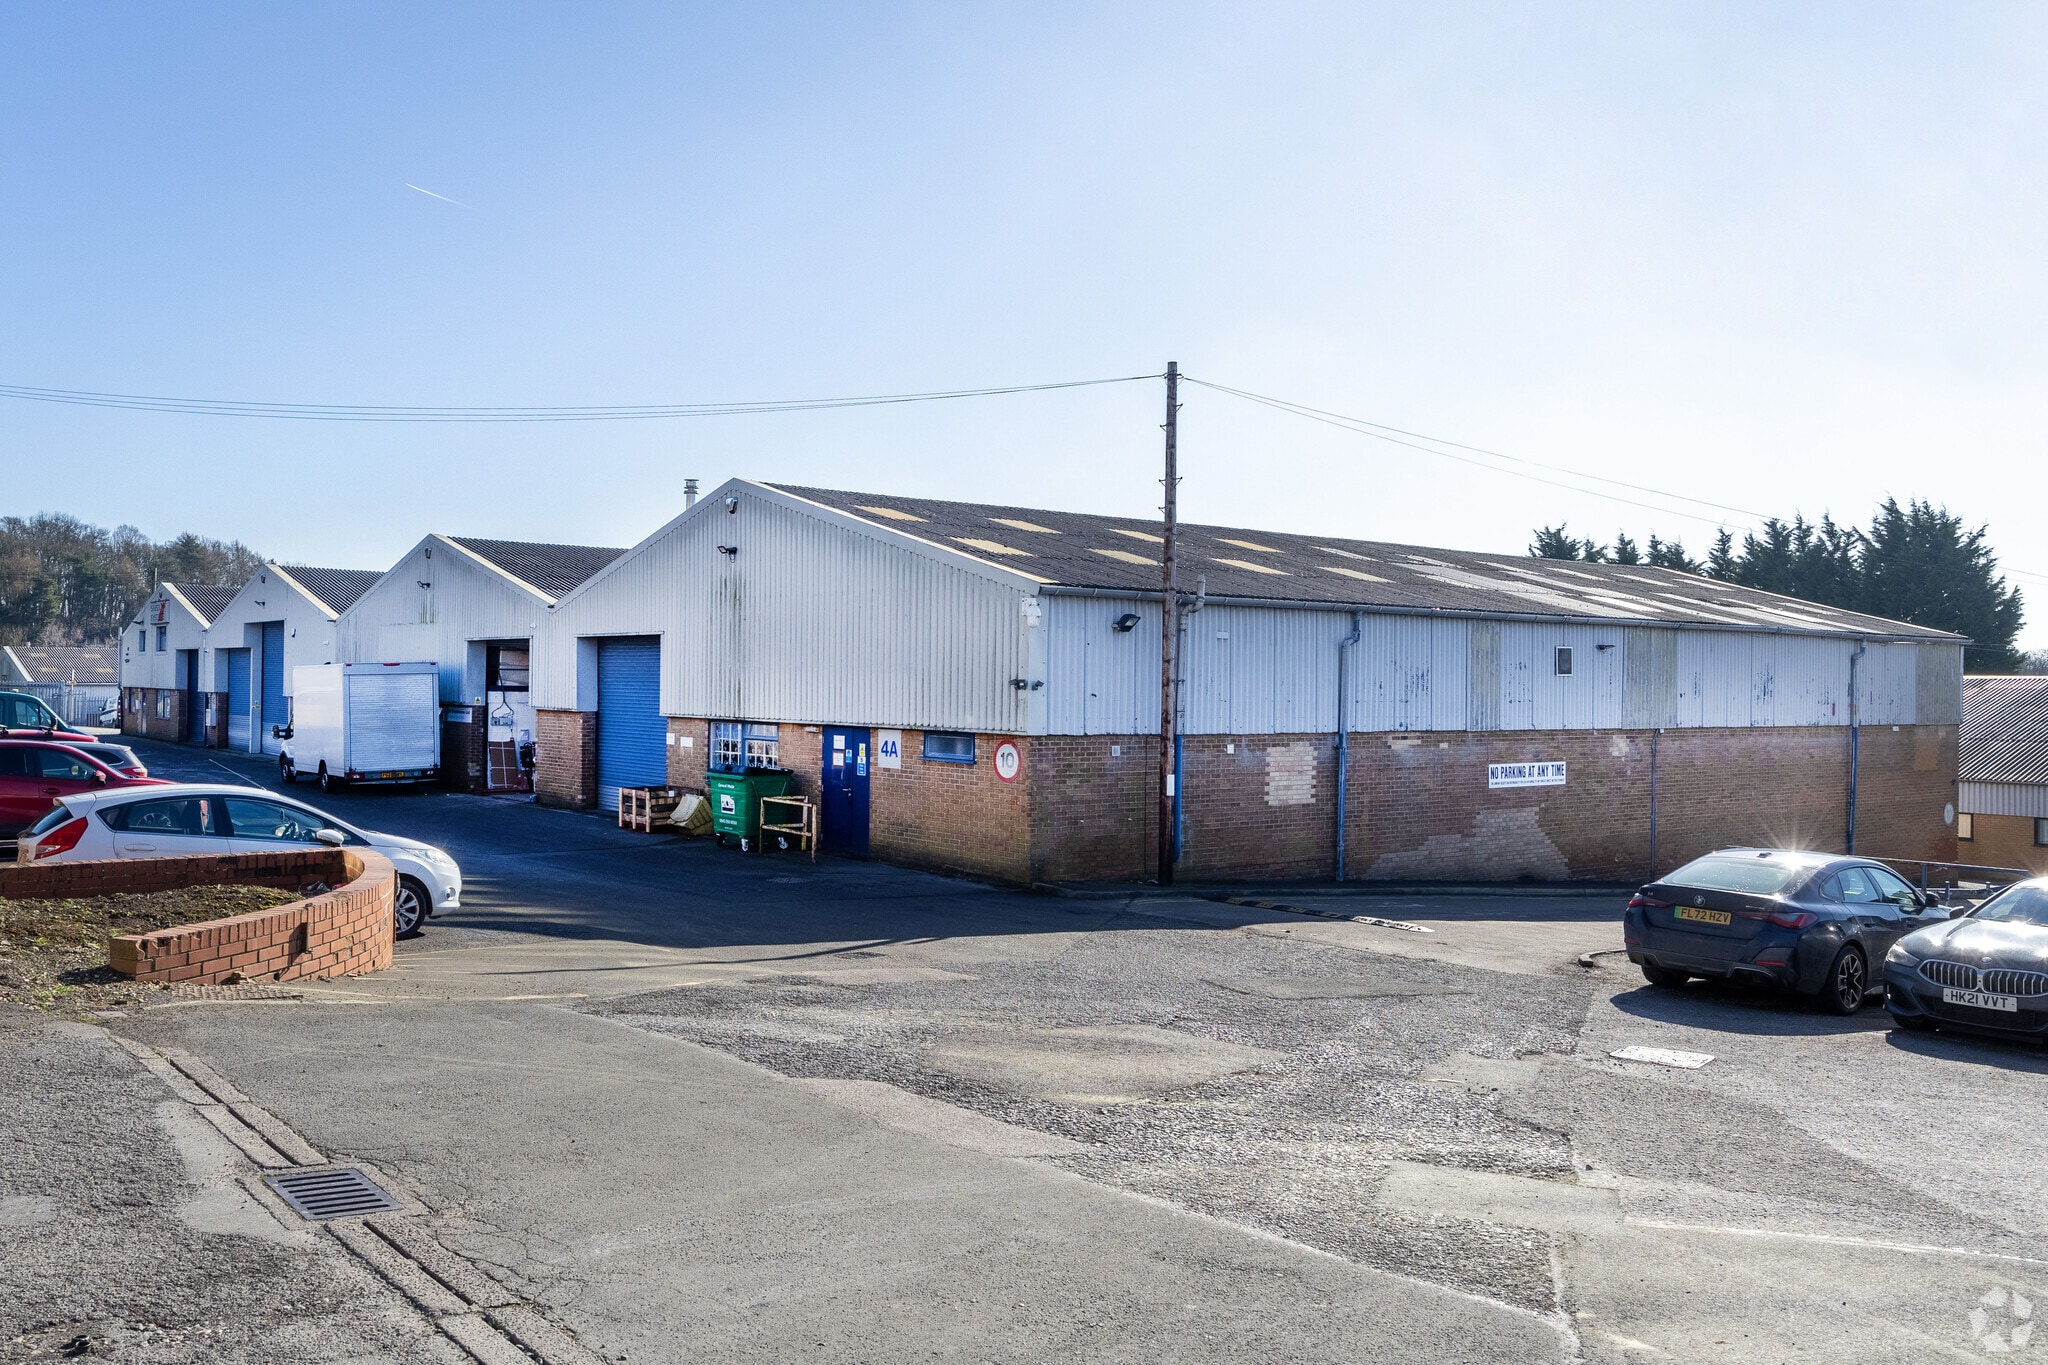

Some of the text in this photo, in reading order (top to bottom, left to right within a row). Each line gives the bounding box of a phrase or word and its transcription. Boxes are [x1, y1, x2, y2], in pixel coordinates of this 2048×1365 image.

[881, 740, 898, 757] 4A
[1001, 752, 1014, 768] 10
[1491, 763, 1565, 779] NO PARKING AT ANY TIME
[1680, 908, 1730, 923] FL72 HZV
[1950, 990, 2008, 1009] HK21 VVT
